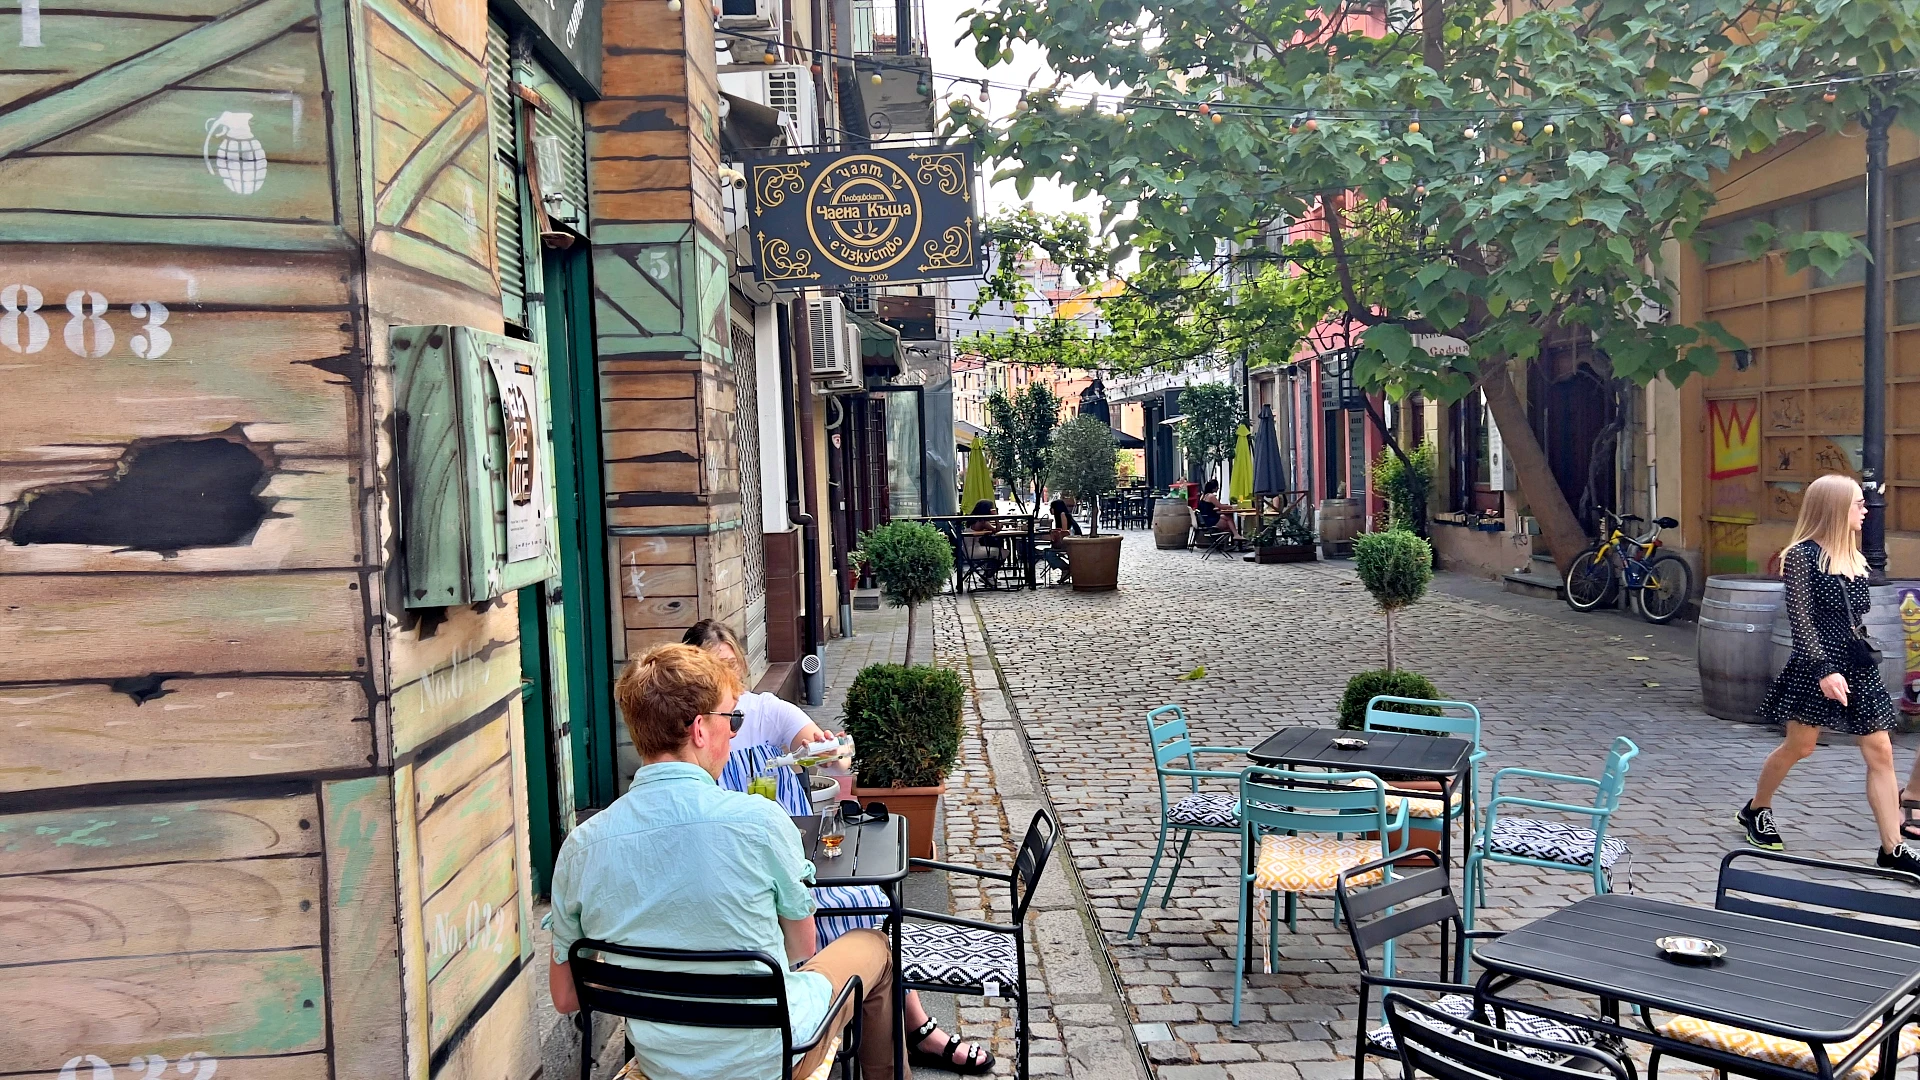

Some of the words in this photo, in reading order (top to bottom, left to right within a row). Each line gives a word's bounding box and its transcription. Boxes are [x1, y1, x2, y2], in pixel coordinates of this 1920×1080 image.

[841, 193, 885, 203] Пловдивската
[816, 205, 861, 220] Чаена
[867, 203, 912, 218] Къща
